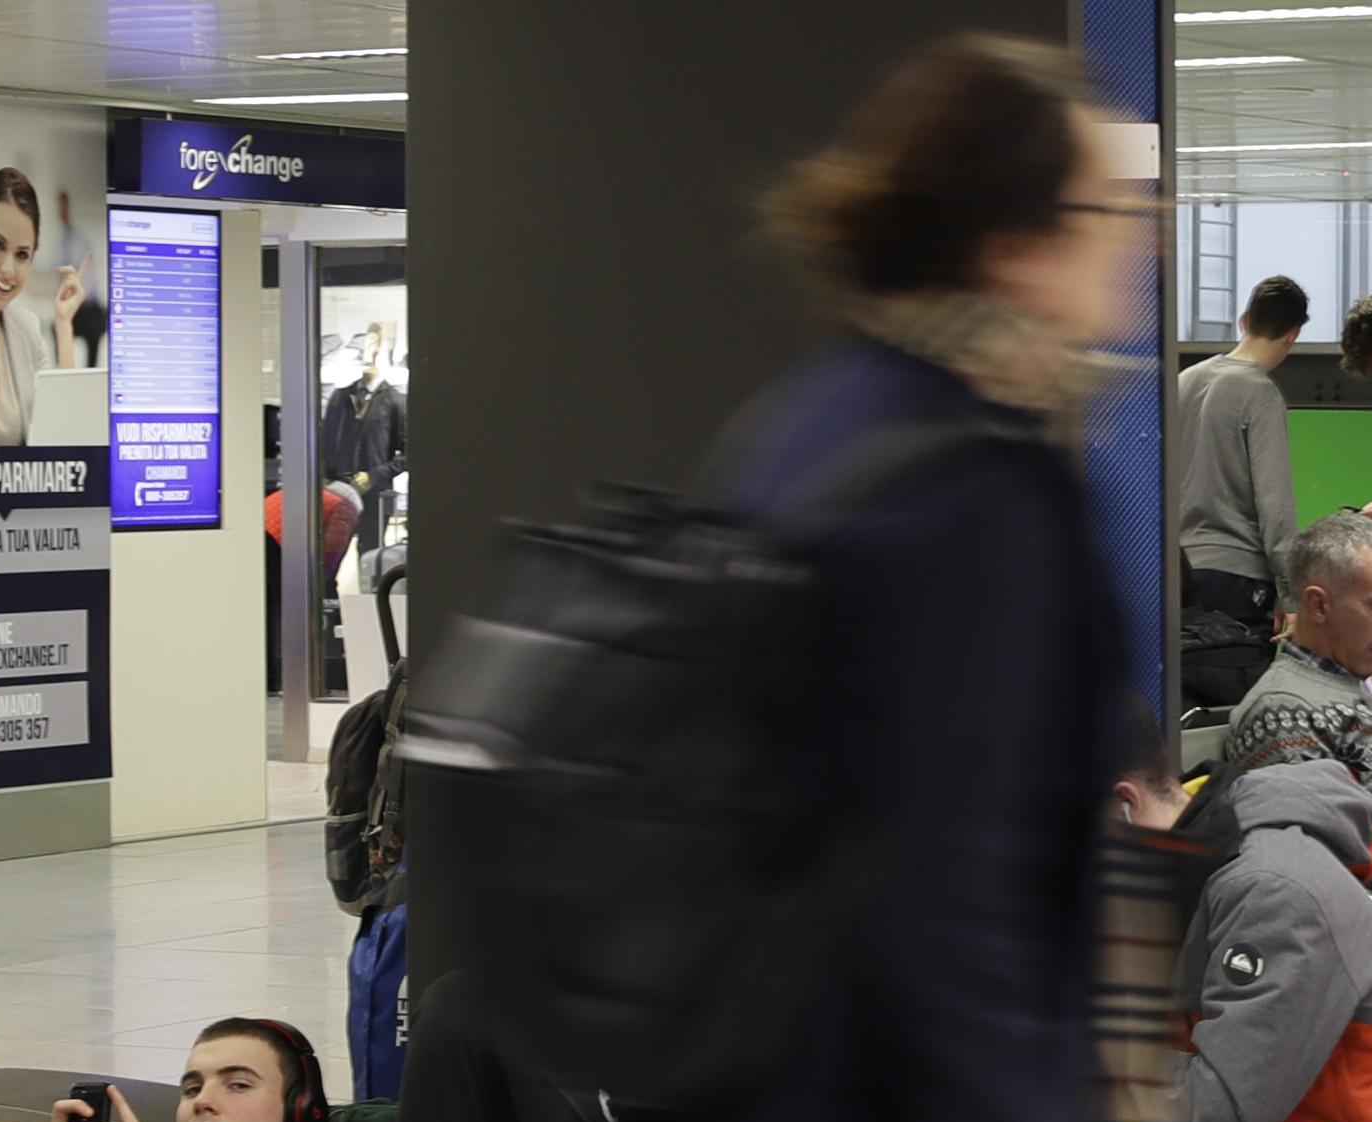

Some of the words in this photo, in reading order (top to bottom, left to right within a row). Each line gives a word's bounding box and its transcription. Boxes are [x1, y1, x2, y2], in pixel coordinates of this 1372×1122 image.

[6, 528, 29, 552] TUA
[33, 527, 80, 551] VALUTA
[0, 719, 23, 742] 305
[26, 717, 49, 740] 357
